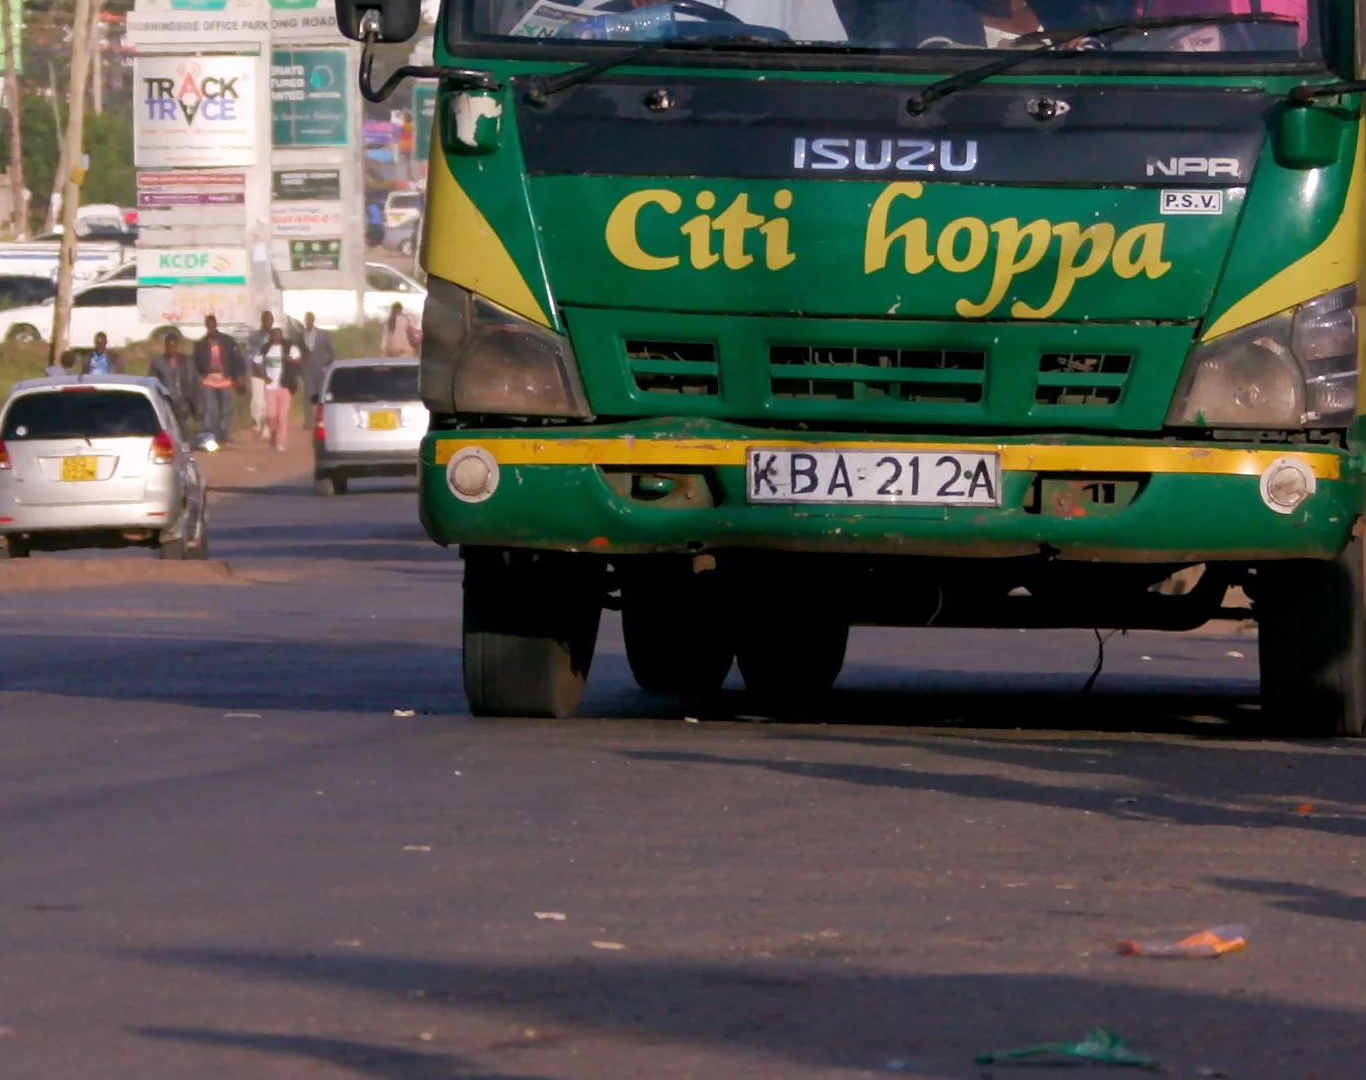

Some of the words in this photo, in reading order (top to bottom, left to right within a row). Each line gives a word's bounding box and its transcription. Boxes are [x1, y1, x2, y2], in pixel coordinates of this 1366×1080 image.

[792, 137, 978, 172] ISUZU
[1146, 157, 1240, 177] NPR
[1165, 194, 1216, 209] P.S.V.
[606, 190, 796, 270] Citi
[863, 182, 1173, 319] hoppa
